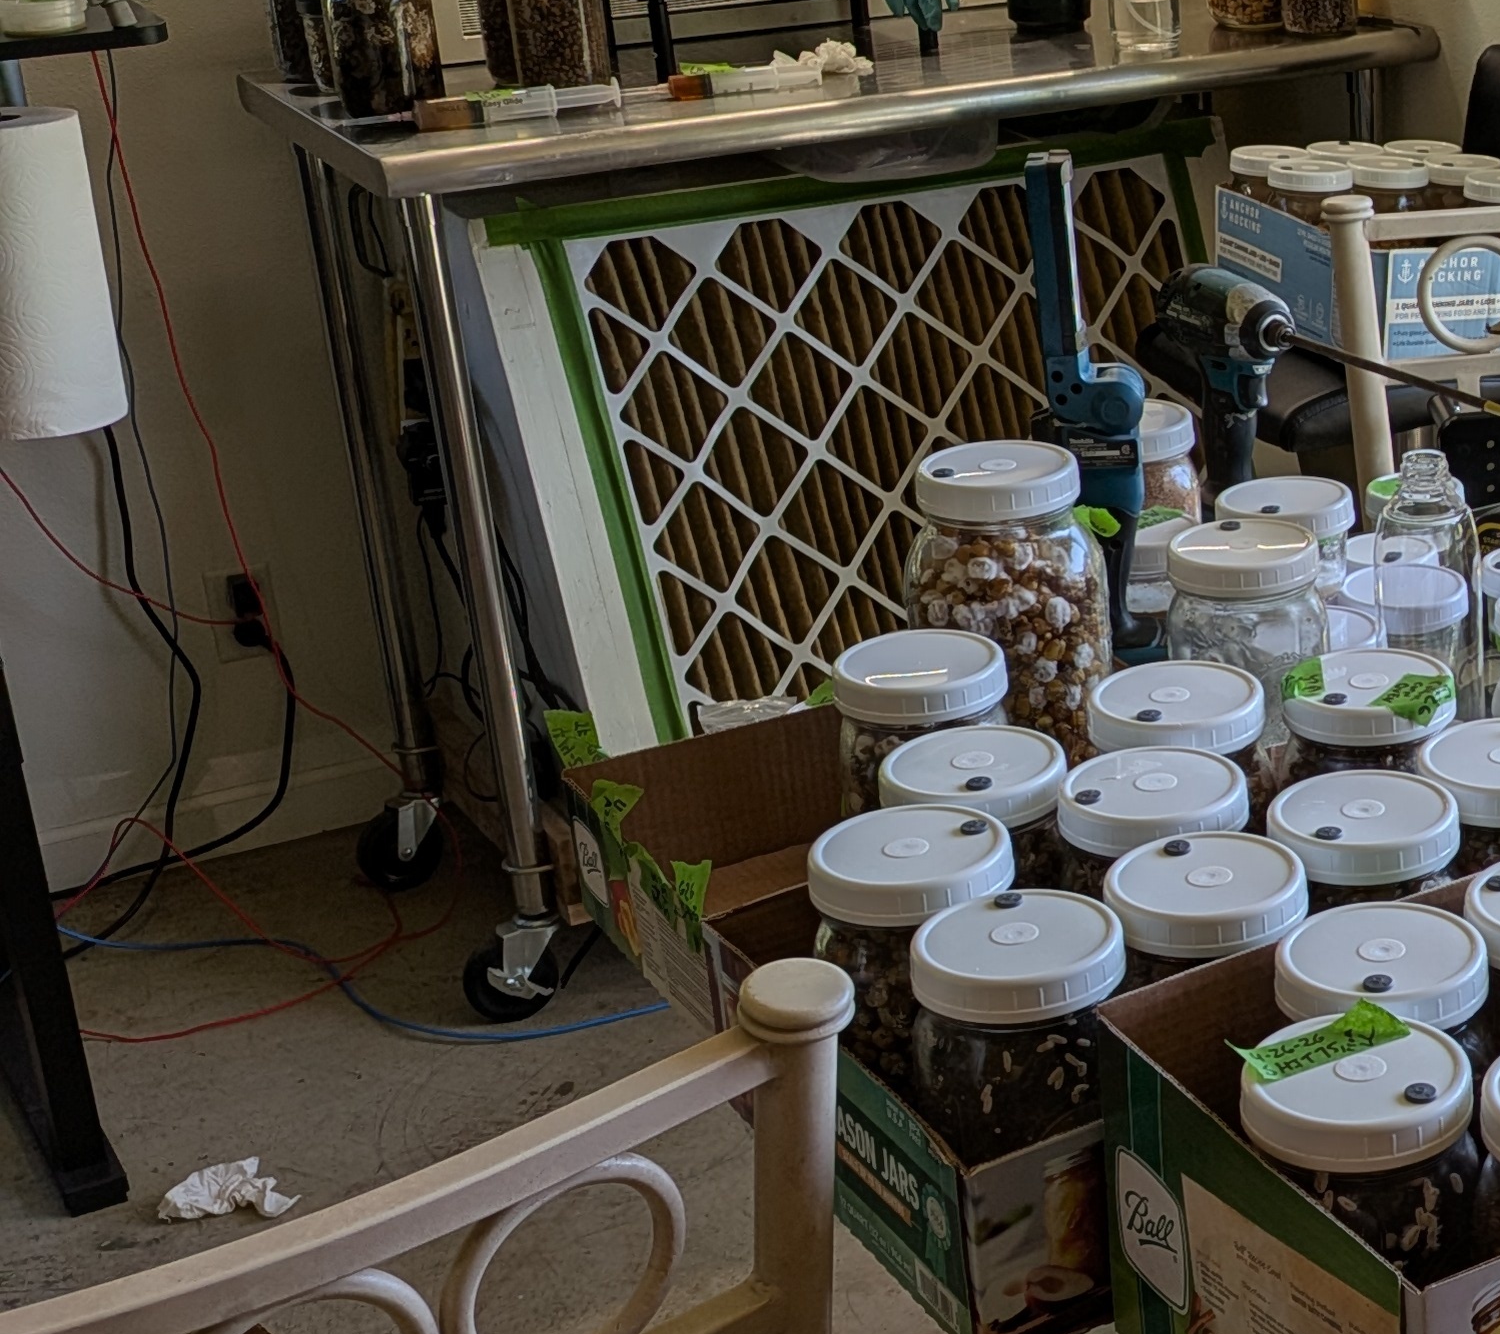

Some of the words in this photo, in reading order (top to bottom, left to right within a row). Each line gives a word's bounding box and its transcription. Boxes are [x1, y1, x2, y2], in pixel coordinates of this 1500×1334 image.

[502, 97, 524, 106] Glide
[1229, 198, 1260, 219] ANCHOR
[1228, 212, 1262, 234] HOCKING
[579, 841, 601, 874] Ball
[837, 1105, 877, 1171] ASON
[881, 1146, 920, 1211] JARS
[1124, 1190, 1179, 1255] Ball
